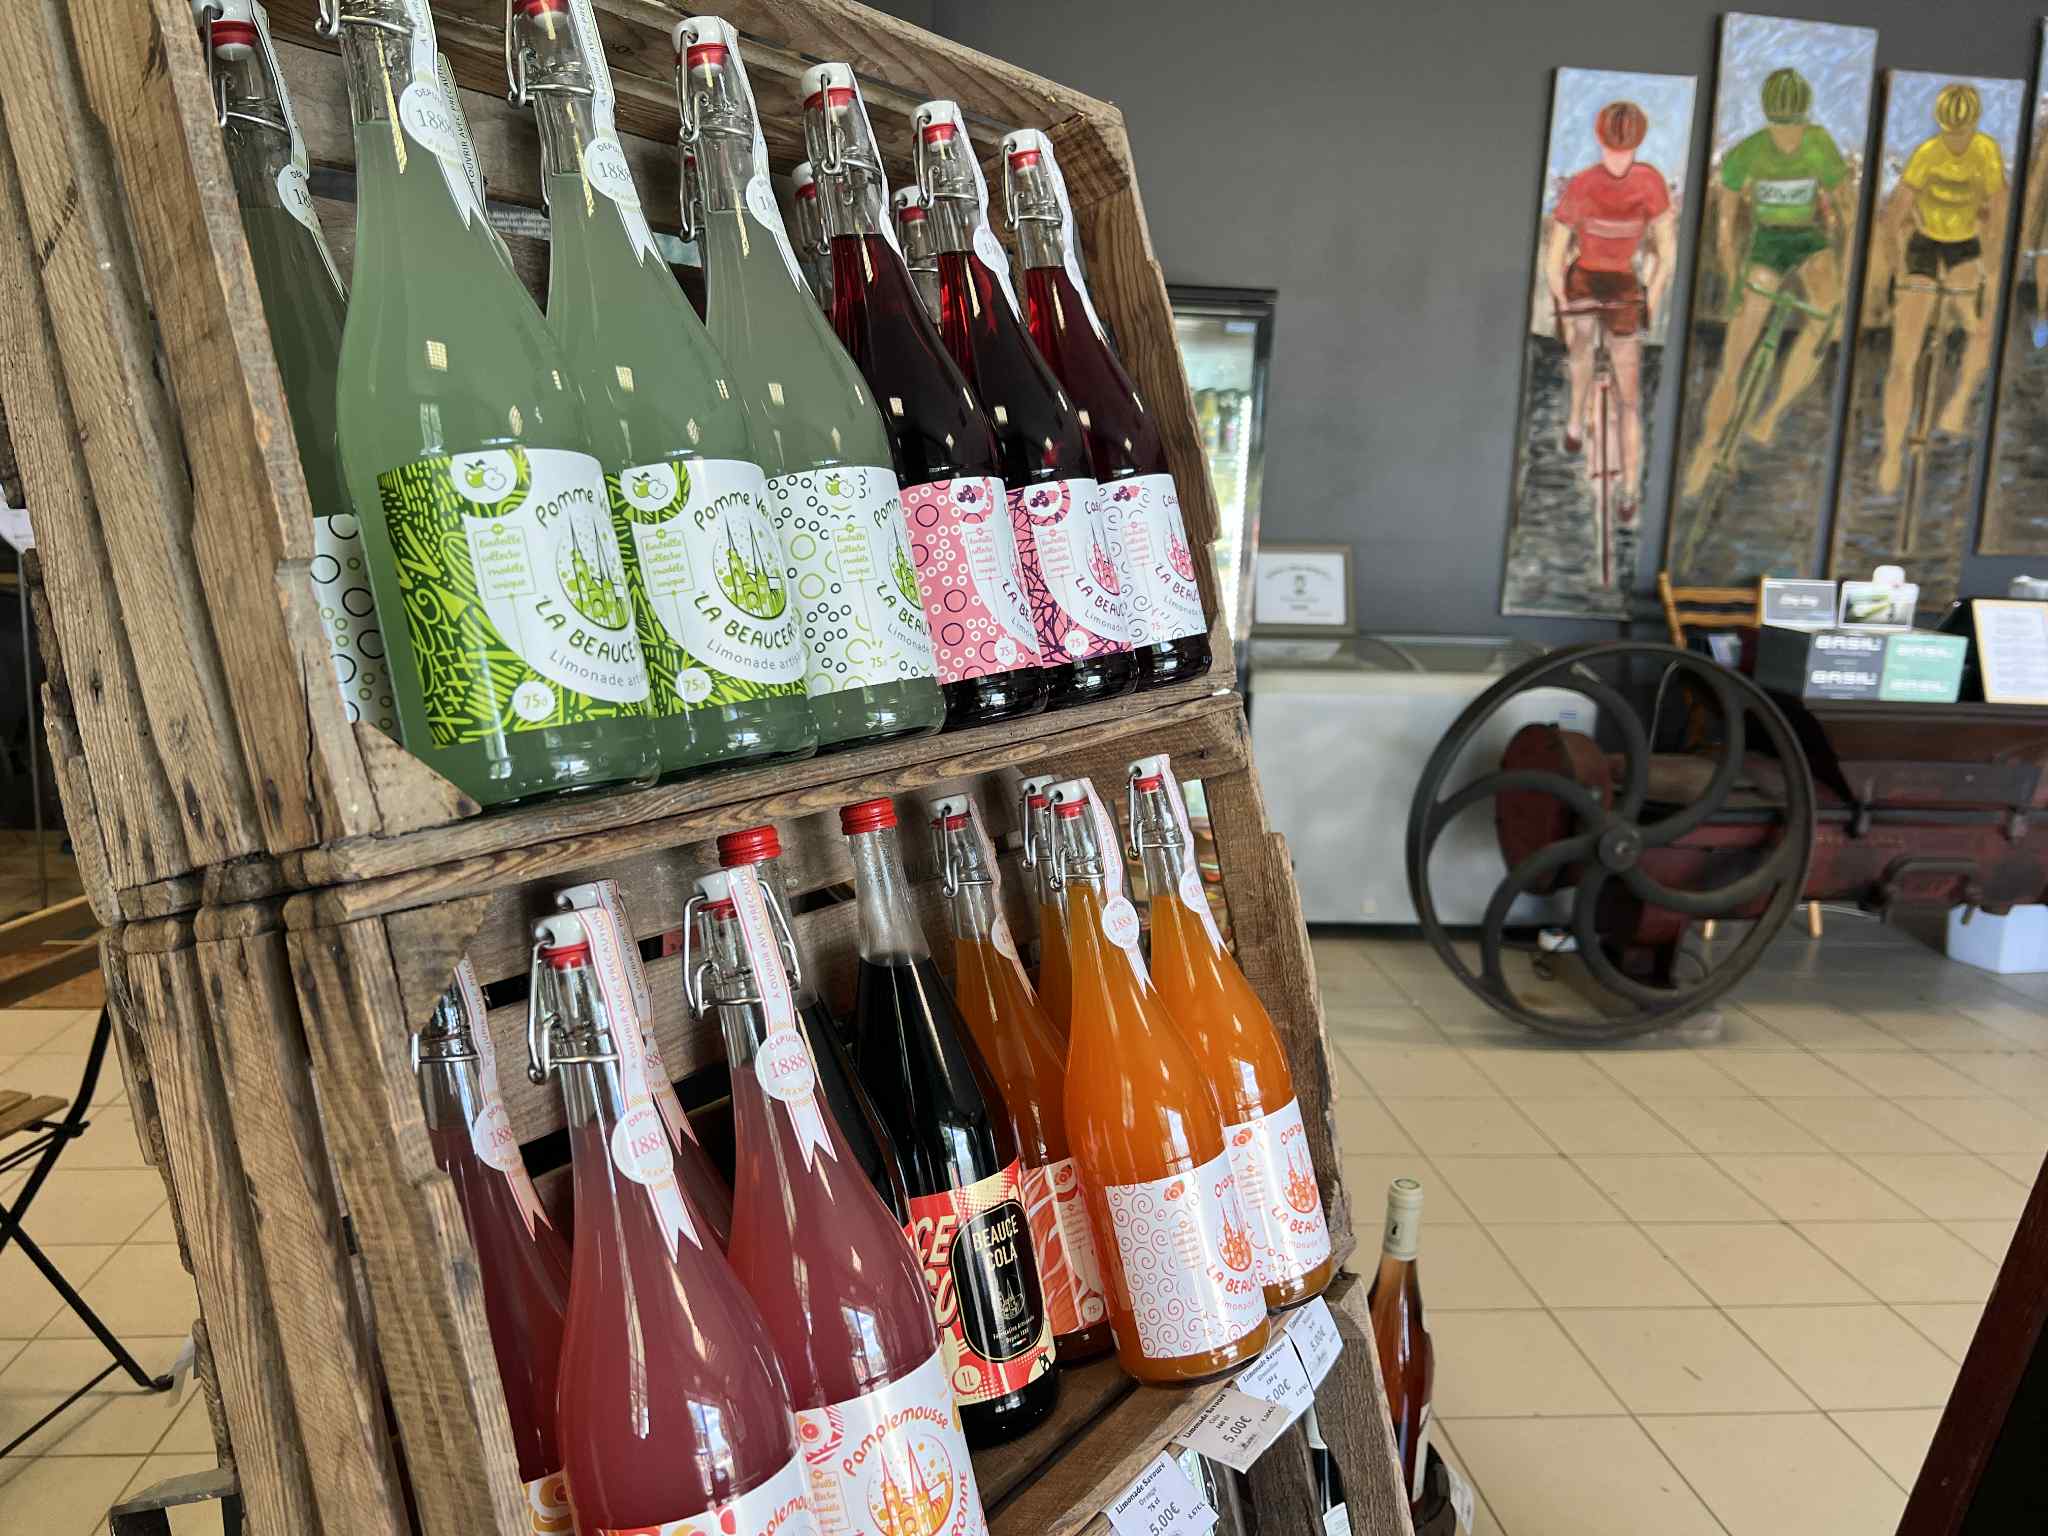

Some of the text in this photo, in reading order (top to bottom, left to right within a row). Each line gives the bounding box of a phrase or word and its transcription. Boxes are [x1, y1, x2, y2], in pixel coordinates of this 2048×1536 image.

[535, 487, 594, 533] Pomme
[694, 492, 751, 533] Pomme
[1075, 576, 1094, 598] LA
[1155, 564, 1172, 585] LA
[876, 583, 897, 608] LA
[1002, 579, 1018, 604] LA
[535, 599, 637, 664] LA BEAUCE
[694, 594, 797, 650] LA BEAUCER
[549, 648, 625, 687] Limonade
[706, 639, 777, 670] Limonade
[770, 1054, 807, 1079] 1888
[971, 1213, 1019, 1251] BEAUCE
[985, 1240, 1019, 1271] COLA
[1206, 1262, 1225, 1285] LA
[1183, 1412, 1209, 1438] Limonade
[1222, 1415, 1252, 1443] 5.00€
[842, 1406, 950, 1477] Pamplemousse
[1115, 1482, 1145, 1514] Limonade
[1147, 1503, 1157, 1513] 75
[1149, 1501, 1181, 1536] 5.00€
